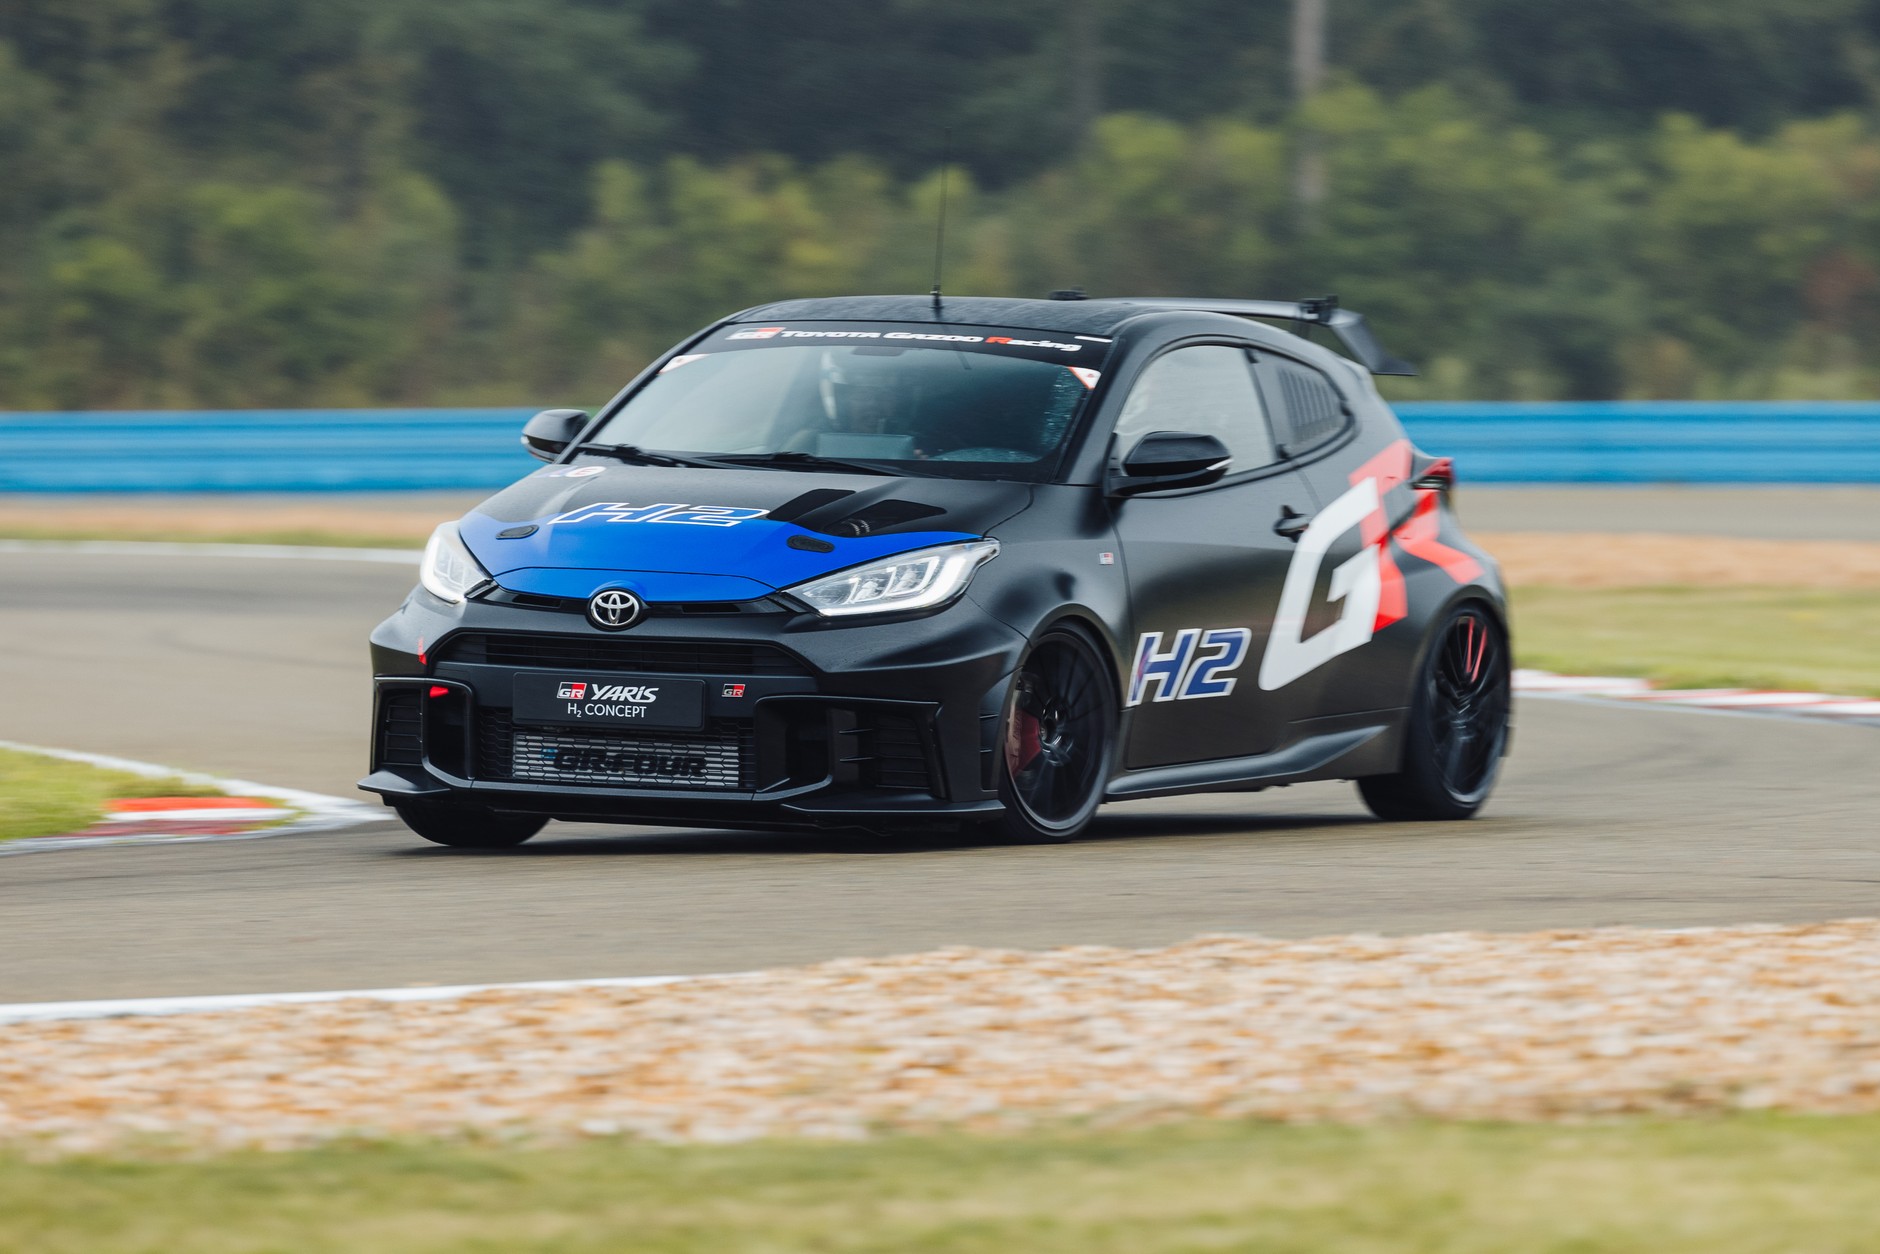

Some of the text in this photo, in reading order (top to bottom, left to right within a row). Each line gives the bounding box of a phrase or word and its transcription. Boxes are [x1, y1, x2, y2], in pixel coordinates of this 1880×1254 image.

[781, 330, 881, 339] TOYOTA
[883, 332, 984, 343] GAZOO
[985, 336, 1082, 352] Racing
[547, 502, 770, 527] H2
[1126, 628, 1252, 707] H2
[558, 687, 585, 699] GR
[584, 703, 647, 718] CONCEPT
